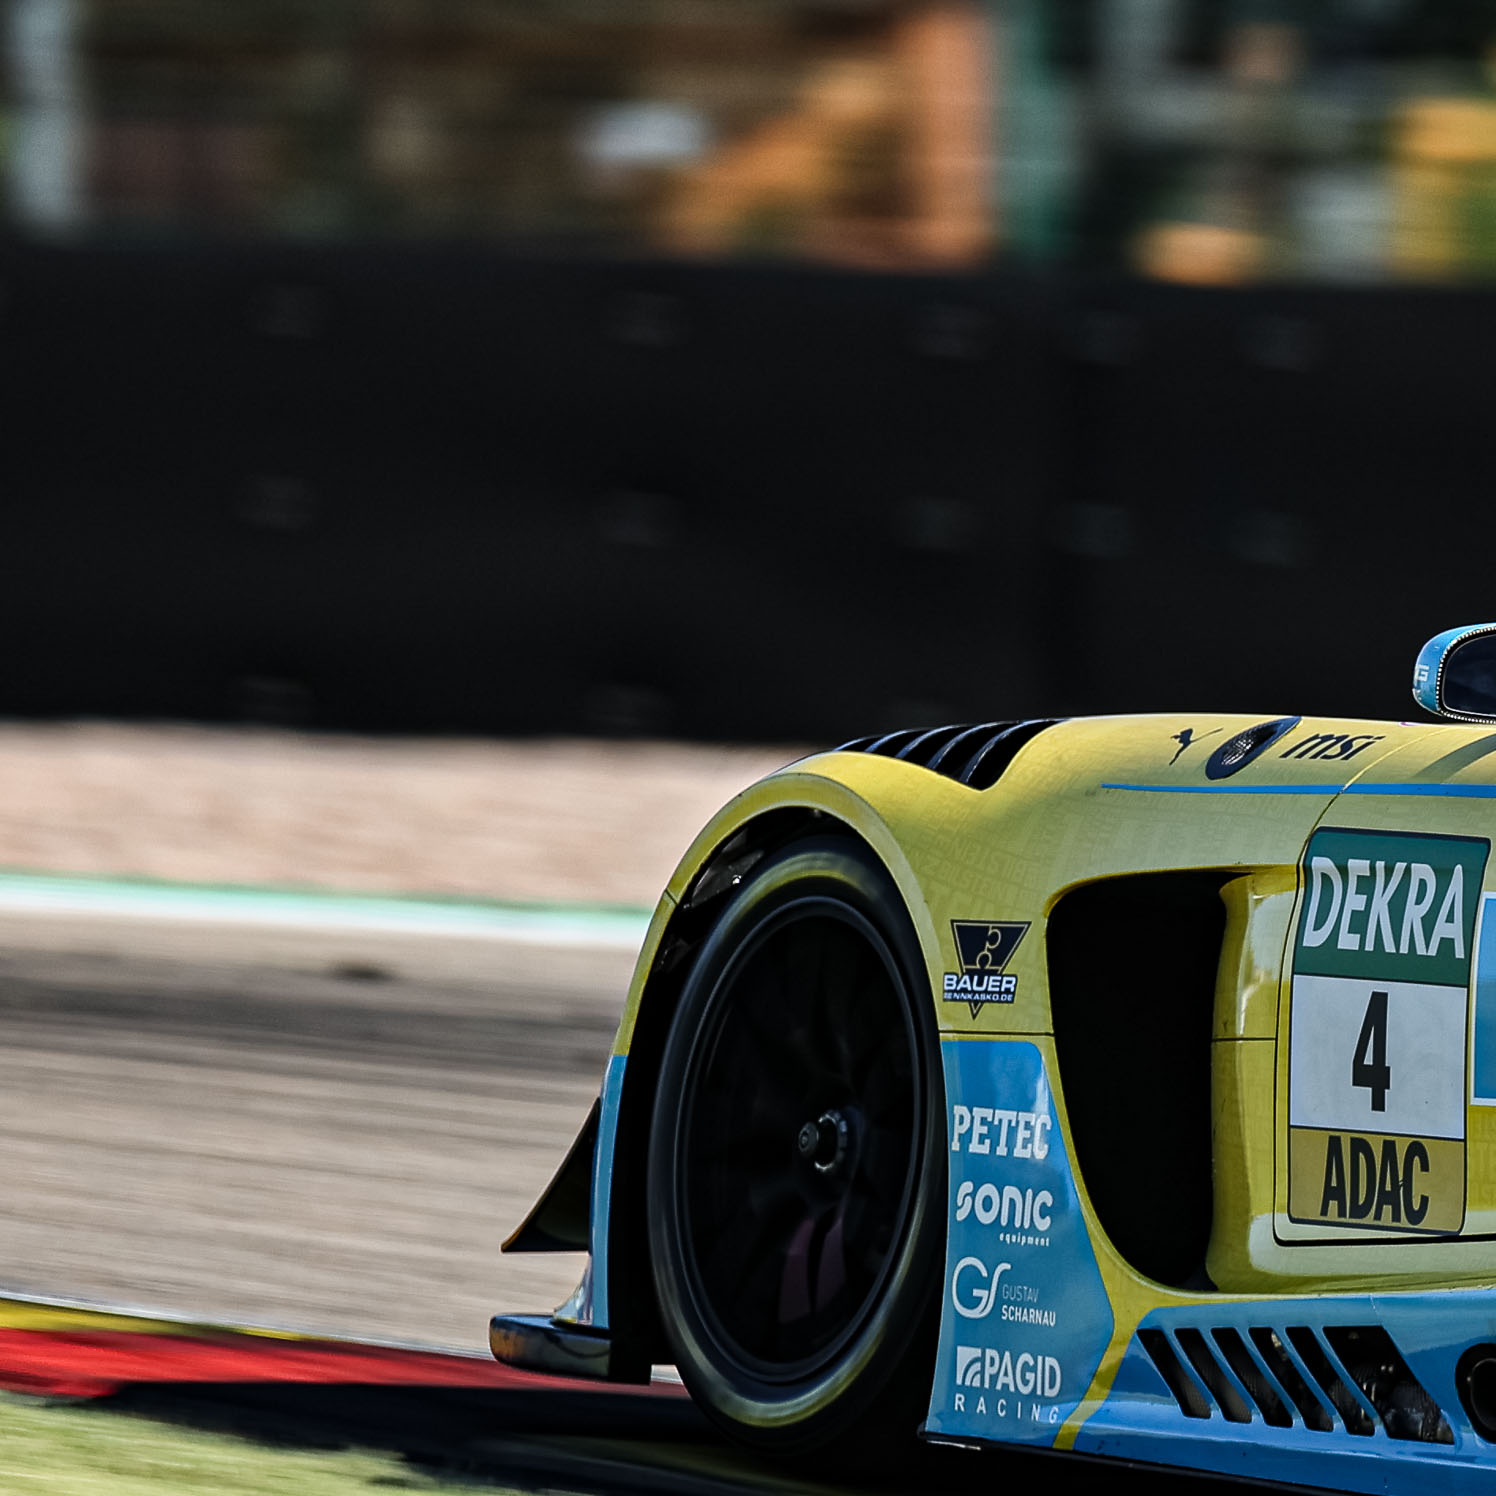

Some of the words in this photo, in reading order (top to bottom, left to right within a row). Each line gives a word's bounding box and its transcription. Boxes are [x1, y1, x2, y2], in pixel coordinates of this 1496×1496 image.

[1303, 857, 1464, 959] DEKRA
[944, 974, 1016, 992] BAUER
[1352, 991, 1390, 1111] 4
[951, 1105, 1052, 1159] PETEC
[1320, 1136, 1430, 1225] ADAC
[999, 1232, 1049, 1246] equipment
[1003, 1284, 1039, 1302] GUSTAV
[1002, 1305, 1056, 1326] SCHARNAU
[984, 1348, 1061, 1397] PAGID
[955, 1393, 1058, 1424] RACING
